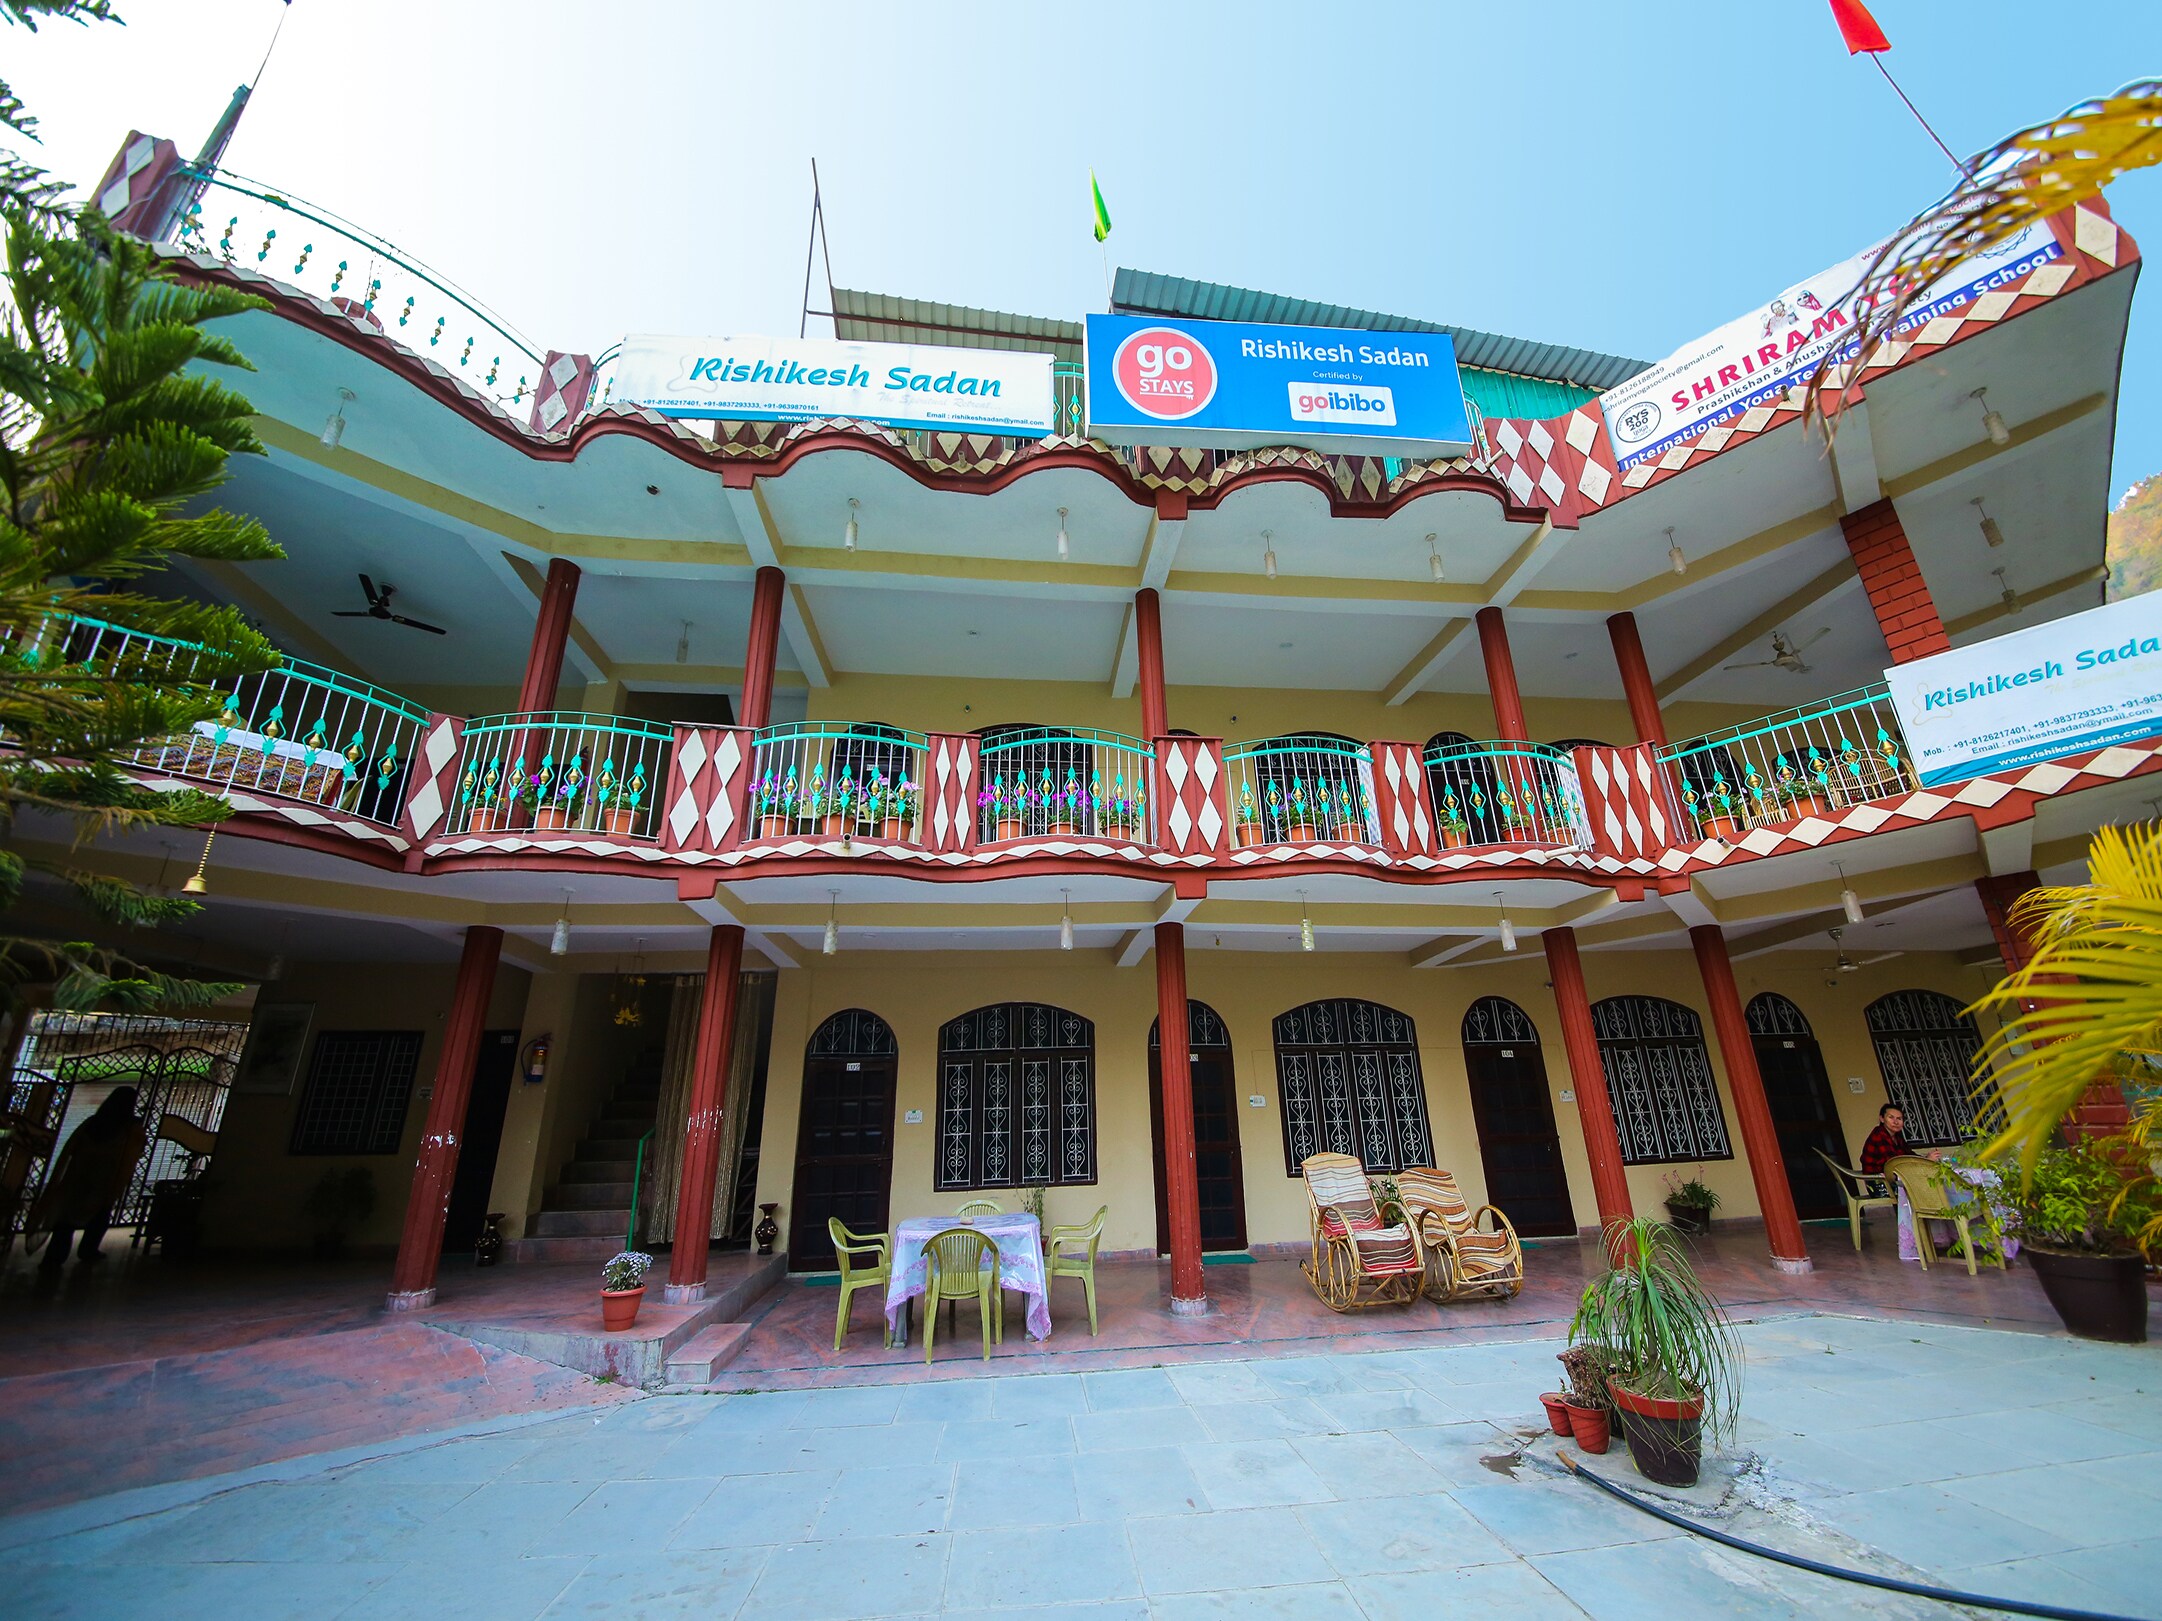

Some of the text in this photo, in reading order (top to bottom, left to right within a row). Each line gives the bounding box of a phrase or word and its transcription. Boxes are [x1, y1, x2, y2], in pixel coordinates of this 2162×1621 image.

[1136, 343, 1193, 378] go
[1240, 338, 1429, 368] Rishikesh Sadan
[1623, 405, 1737, 471] International
[1972, 246, 2058, 297] School
[1671, 308, 1848, 412] SHRIRAM
[688, 356, 1002, 398] Rishikesh Sadan
[1139, 378, 1194, 395] STAYS
[1312, 370, 1364, 383] Certified by
[1697, 372, 1771, 415] Prashikshan
[1773, 366, 1783, 375] &
[1298, 391, 1386, 414] goibibo
[1625, 407, 1649, 427] RYS
[926, 411, 946, 420] Email
[951, 414, 1045, 427] rishikeshsadan@ymail.com
[1628, 417, 1649, 432] 200
[1923, 660, 2064, 711] Rishikesh
[1971, 742, 2000, 755] Email
[2007, 706, 2153, 747] rishikeshsadan@ymail.com
[1998, 725, 2152, 767] www.rishikeshsadan.com
[1922, 748, 1945, 758] Mob.
